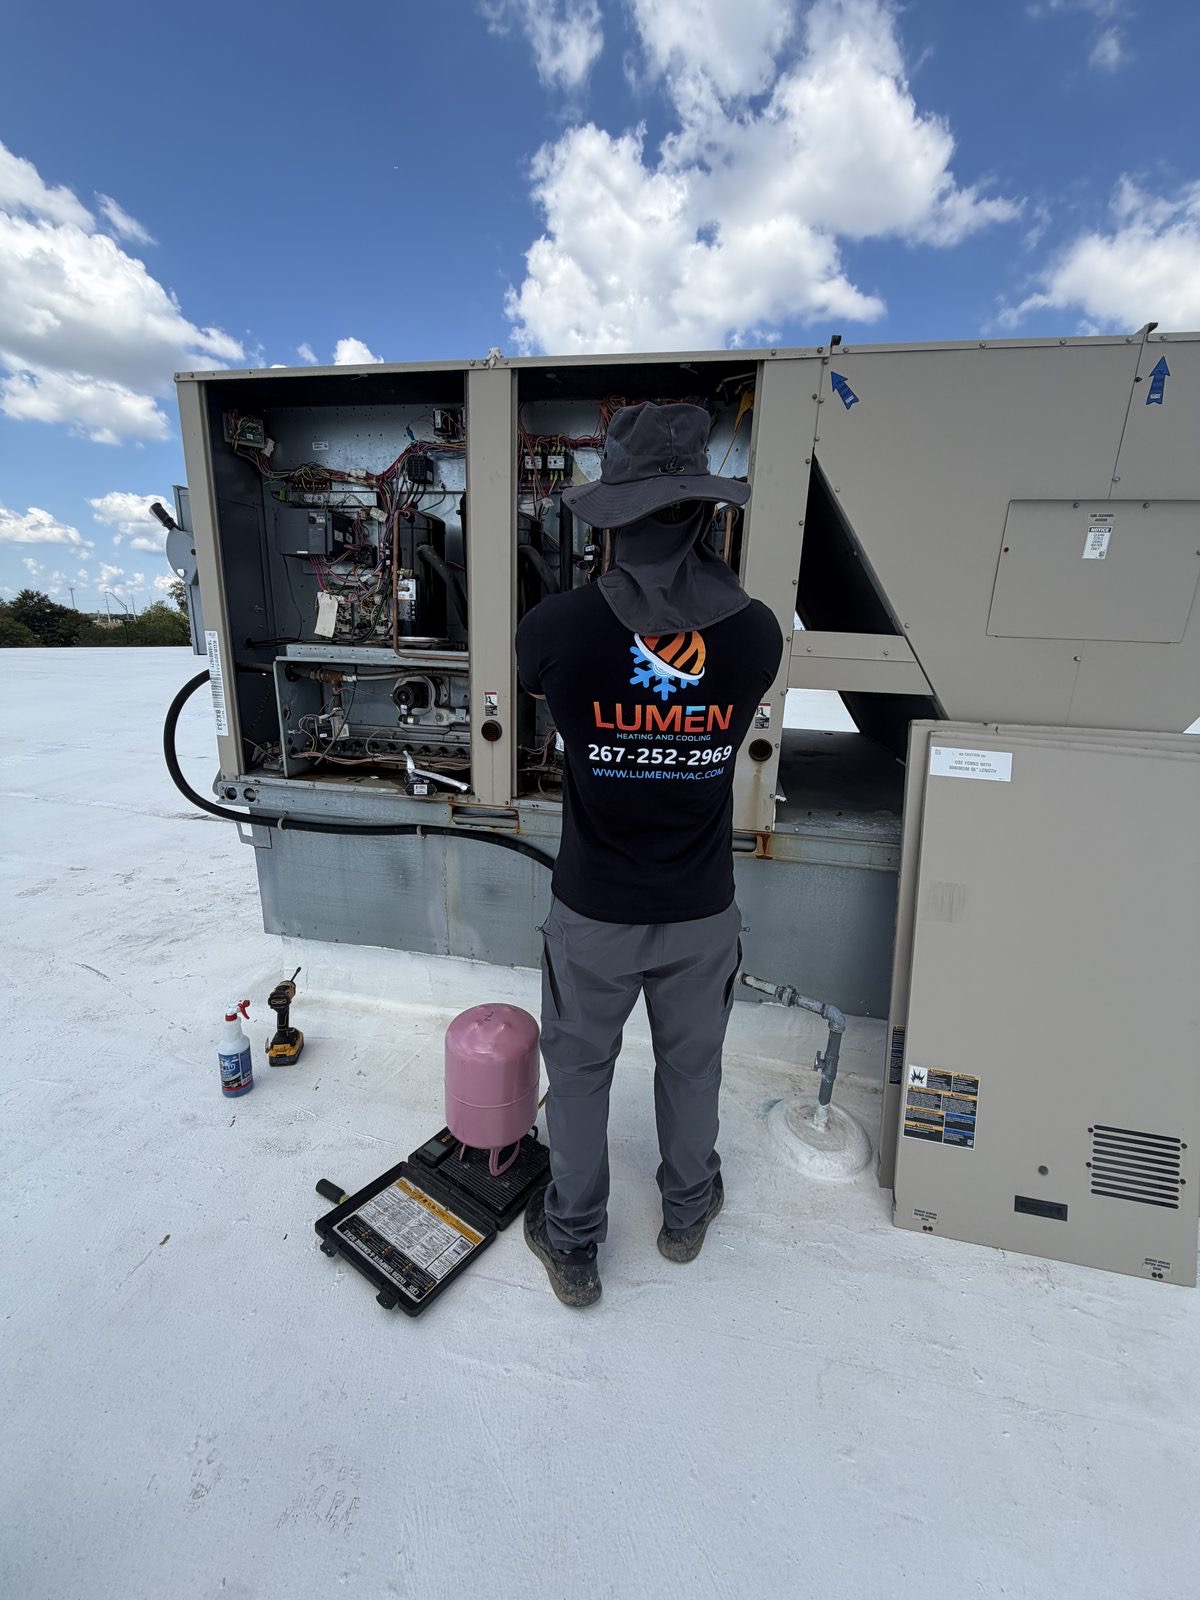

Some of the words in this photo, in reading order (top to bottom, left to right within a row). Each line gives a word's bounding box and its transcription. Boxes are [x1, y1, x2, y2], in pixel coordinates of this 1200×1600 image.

[593, 701, 734, 733] LUMEN
[616, 732, 653, 741] HEATING
[654, 733, 674, 741] AND
[675, 733, 711, 742] COOLING
[587, 744, 733, 766] 267-252-2969
[592, 767, 725, 780] WWW.LUMENHVAC.COM
